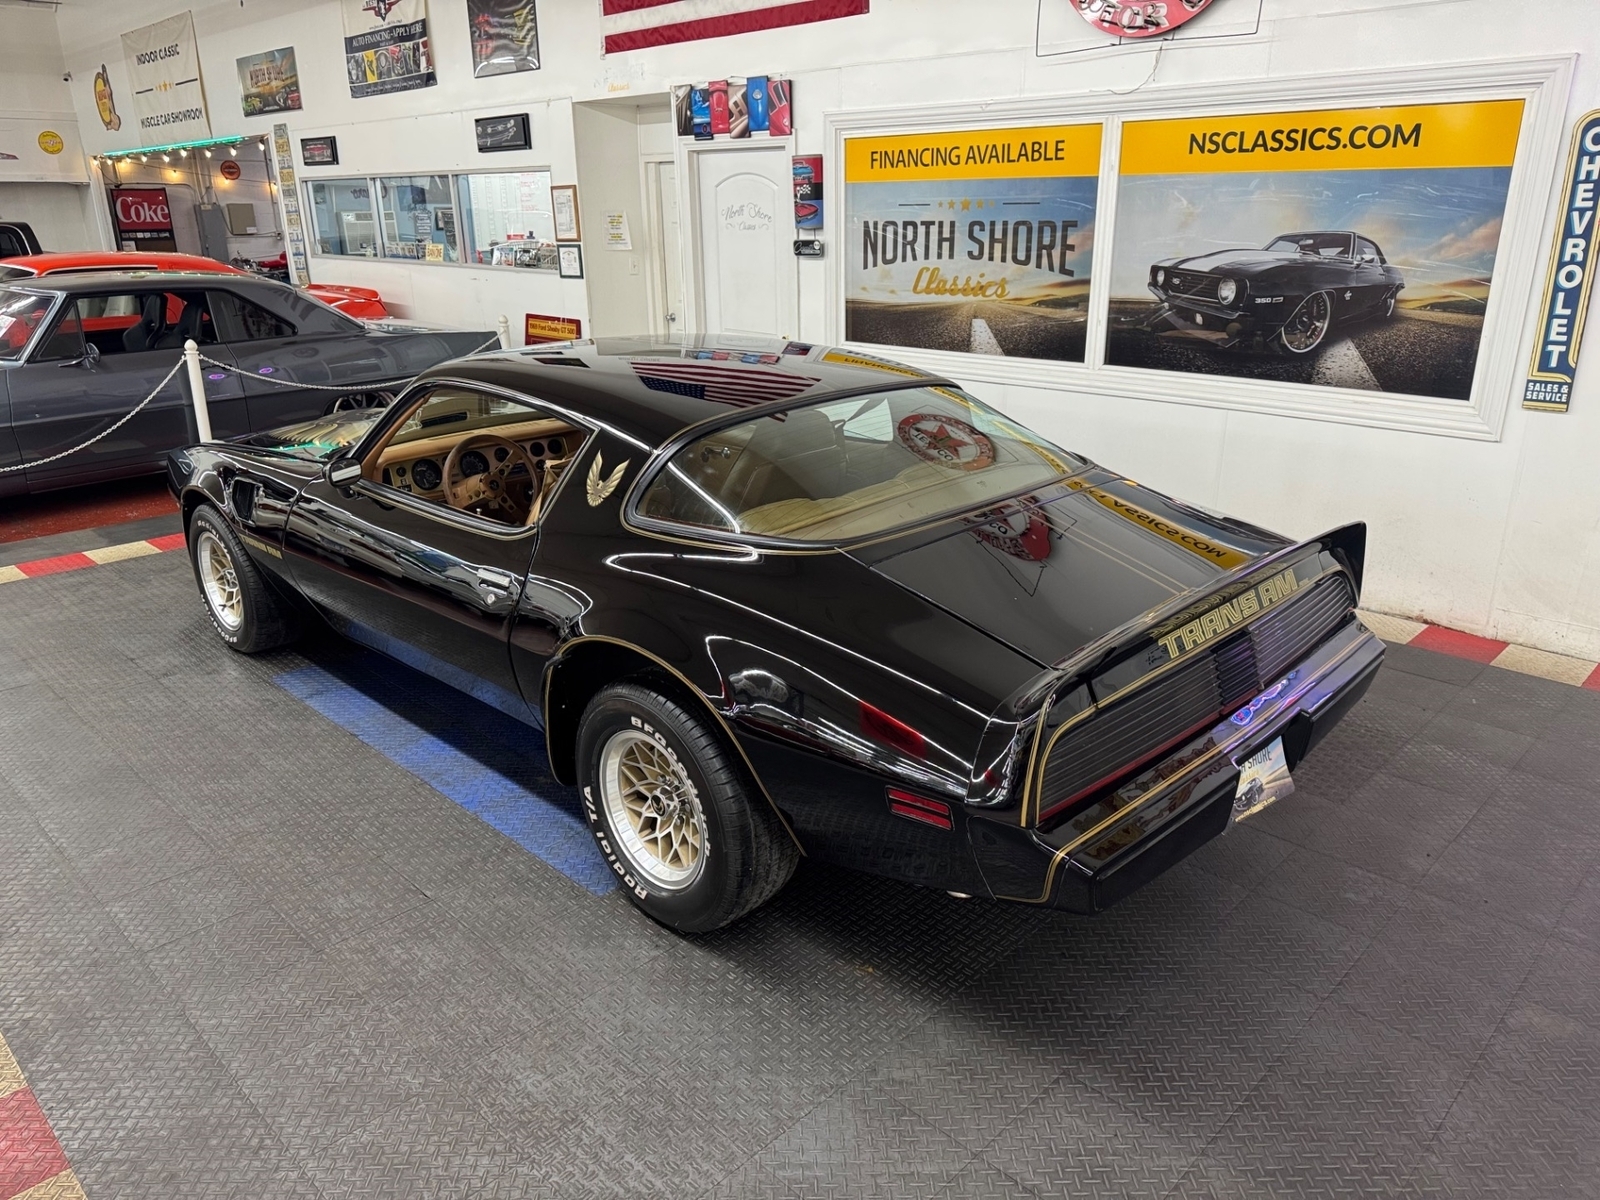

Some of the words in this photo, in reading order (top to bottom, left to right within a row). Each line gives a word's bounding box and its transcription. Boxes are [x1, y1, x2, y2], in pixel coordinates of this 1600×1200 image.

[352, 37, 365, 48] AUTO
[410, 22, 423, 33] HERE
[135, 50, 159, 66] INDOOR
[158, 43, 180, 60] CLASSIC
[140, 114, 161, 130] MUSCLE
[160, 112, 171, 126] CAR
[170, 107, 204, 124] SHOWROOM
[1188, 122, 1423, 156] NSCLASSICS.COM
[869, 145, 961, 170] FINANCING
[964, 139, 1066, 166] AVAILABLE
[115, 196, 170, 223] Coke
[721, 204, 745, 221] North
[746, 202, 772, 223] Shore
[862, 219, 956, 271] NORTH
[967, 219, 1079, 278] SHORE
[1546, 125, 1600, 369] CHEVROLET
[911, 266, 1011, 299] Classics
[547, 325, 560, 334] Shelby
[560, 326, 567, 334] GT
[1525, 391, 1568, 402] SERVICE
[1527, 382, 1559, 393] SALES
[1560, 384, 1569, 394] &
[1158, 590, 1260, 659] TRANS
[1258, 568, 1299, 608] AM
[583, 786, 598, 824] T/A
[596, 831, 648, 900] Radial
